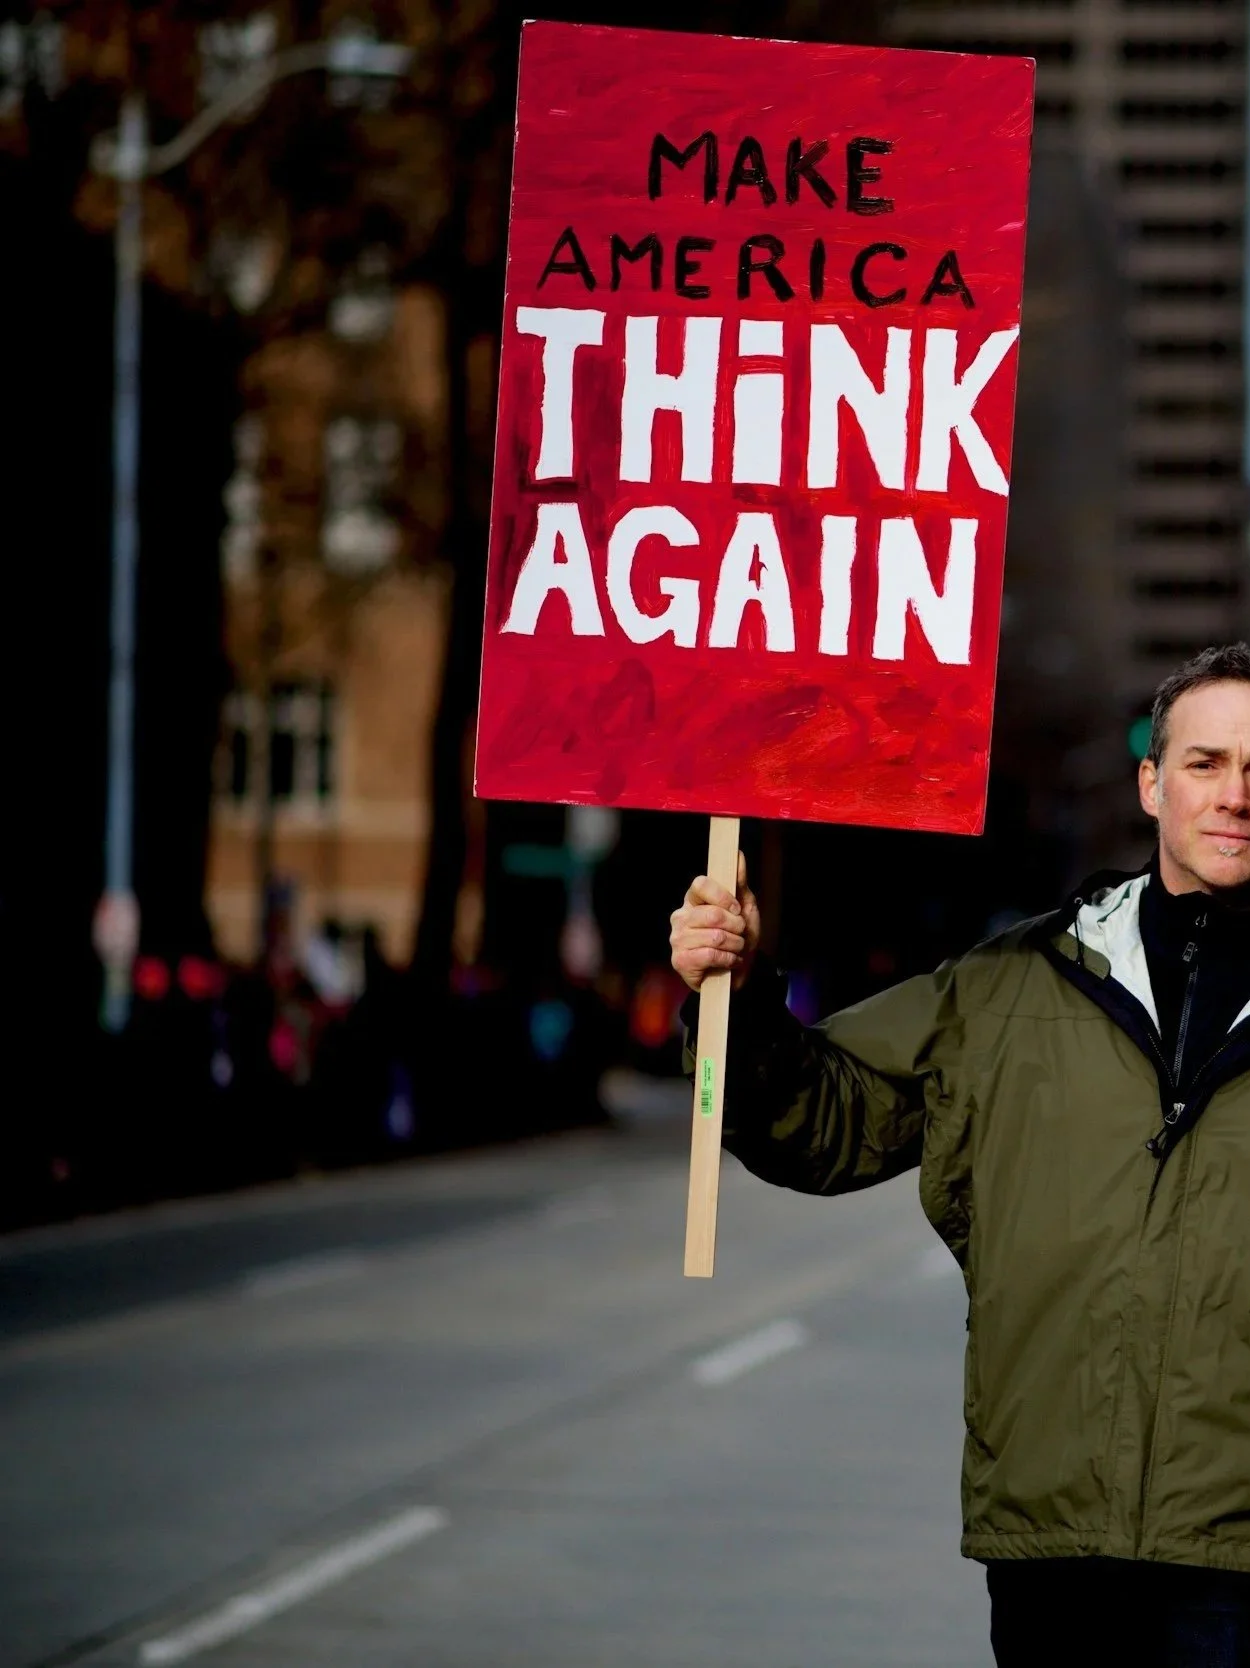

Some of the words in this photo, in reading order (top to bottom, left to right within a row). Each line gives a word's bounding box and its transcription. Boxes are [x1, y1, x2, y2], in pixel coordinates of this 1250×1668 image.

[648, 131, 893, 215] MAKE
[537, 227, 974, 308] AMERICA
[500, 503, 978, 664] AGAIN
